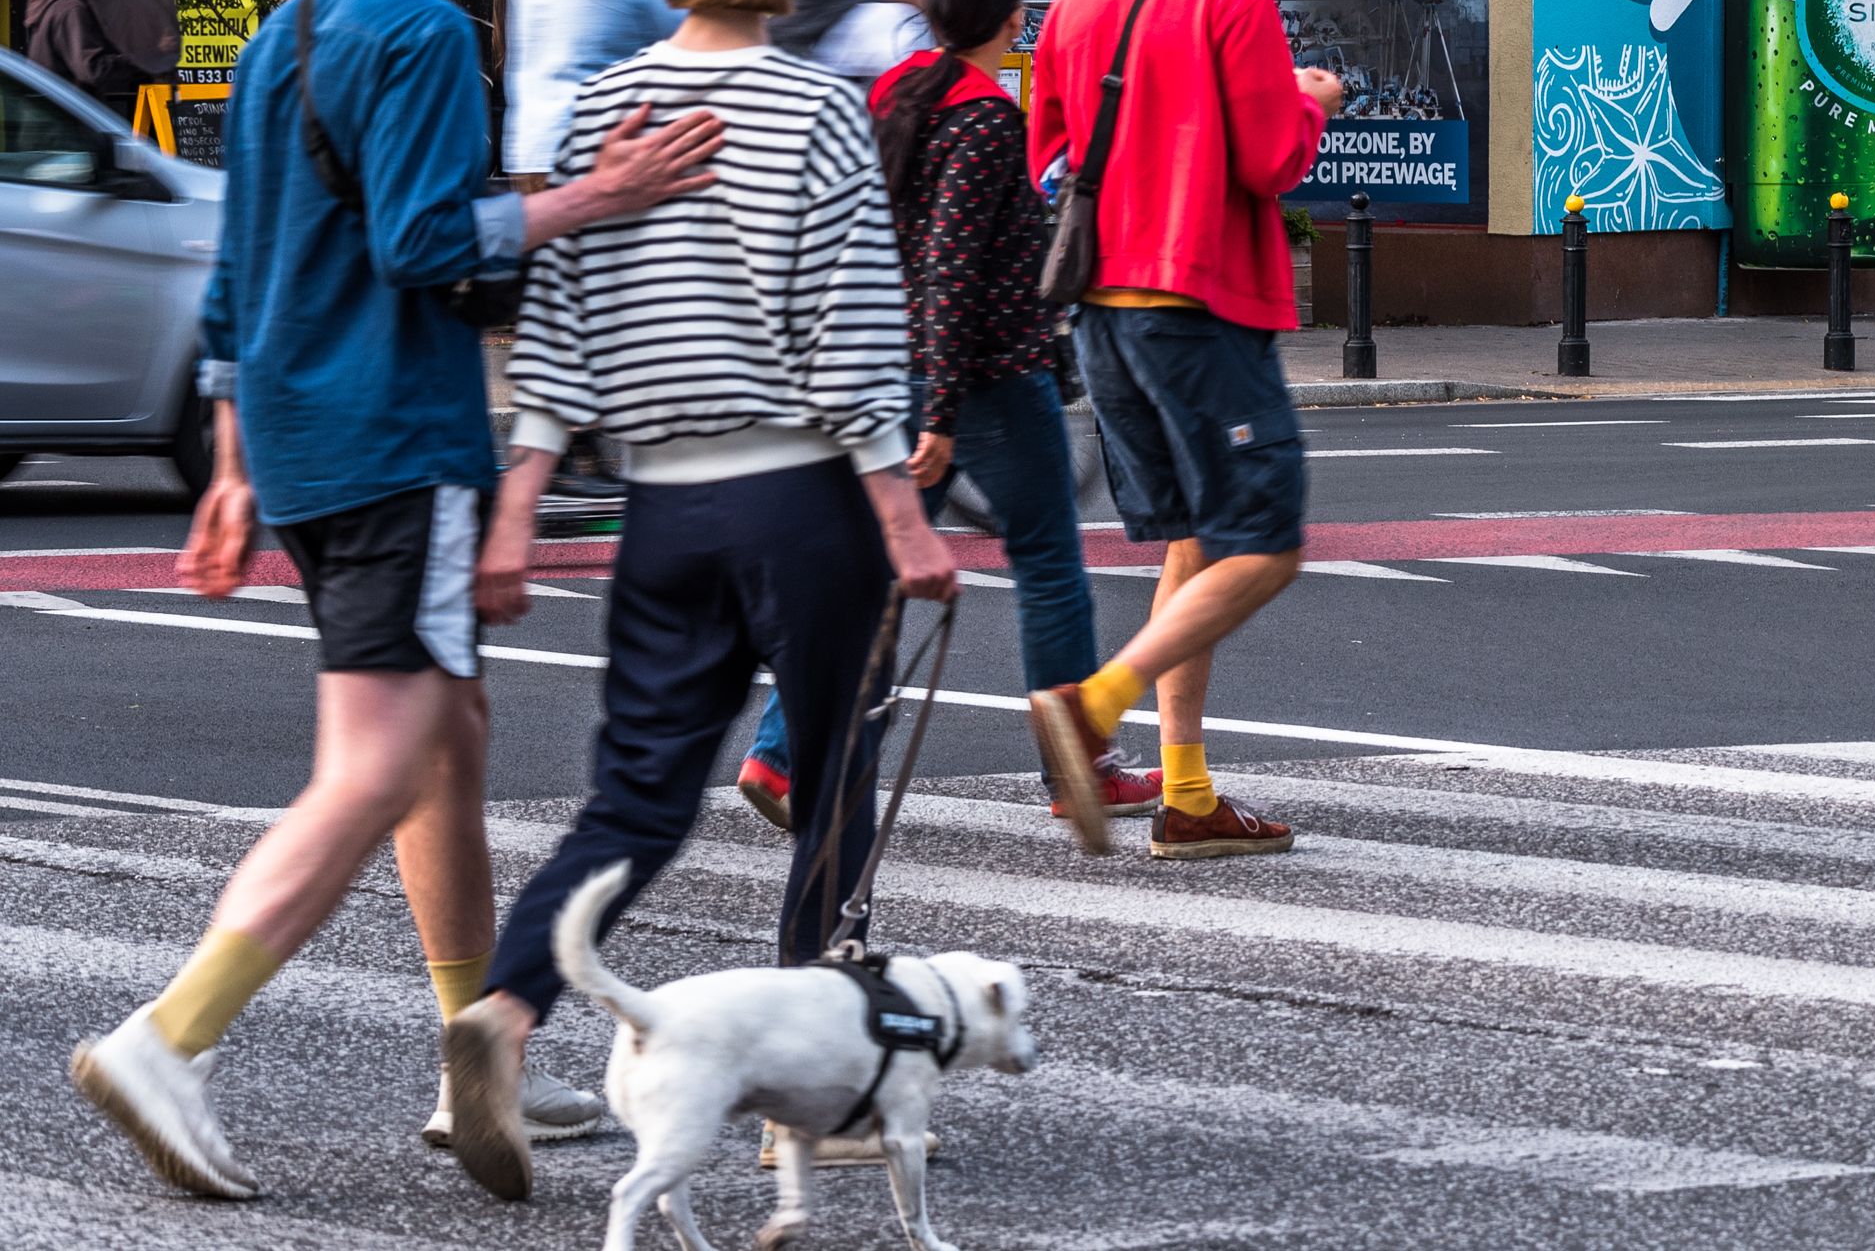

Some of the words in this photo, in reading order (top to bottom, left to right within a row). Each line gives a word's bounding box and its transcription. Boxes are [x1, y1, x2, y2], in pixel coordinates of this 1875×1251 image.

[197, 69, 222, 83] 533
[1836, 64, 1872, 93] PREMIUM
[1799, 79, 1858, 128] PURE
[1409, 131, 1435, 155] BY
[1317, 162, 1338, 184] CI
[1341, 162, 1457, 191] PRZEWAGĘ
